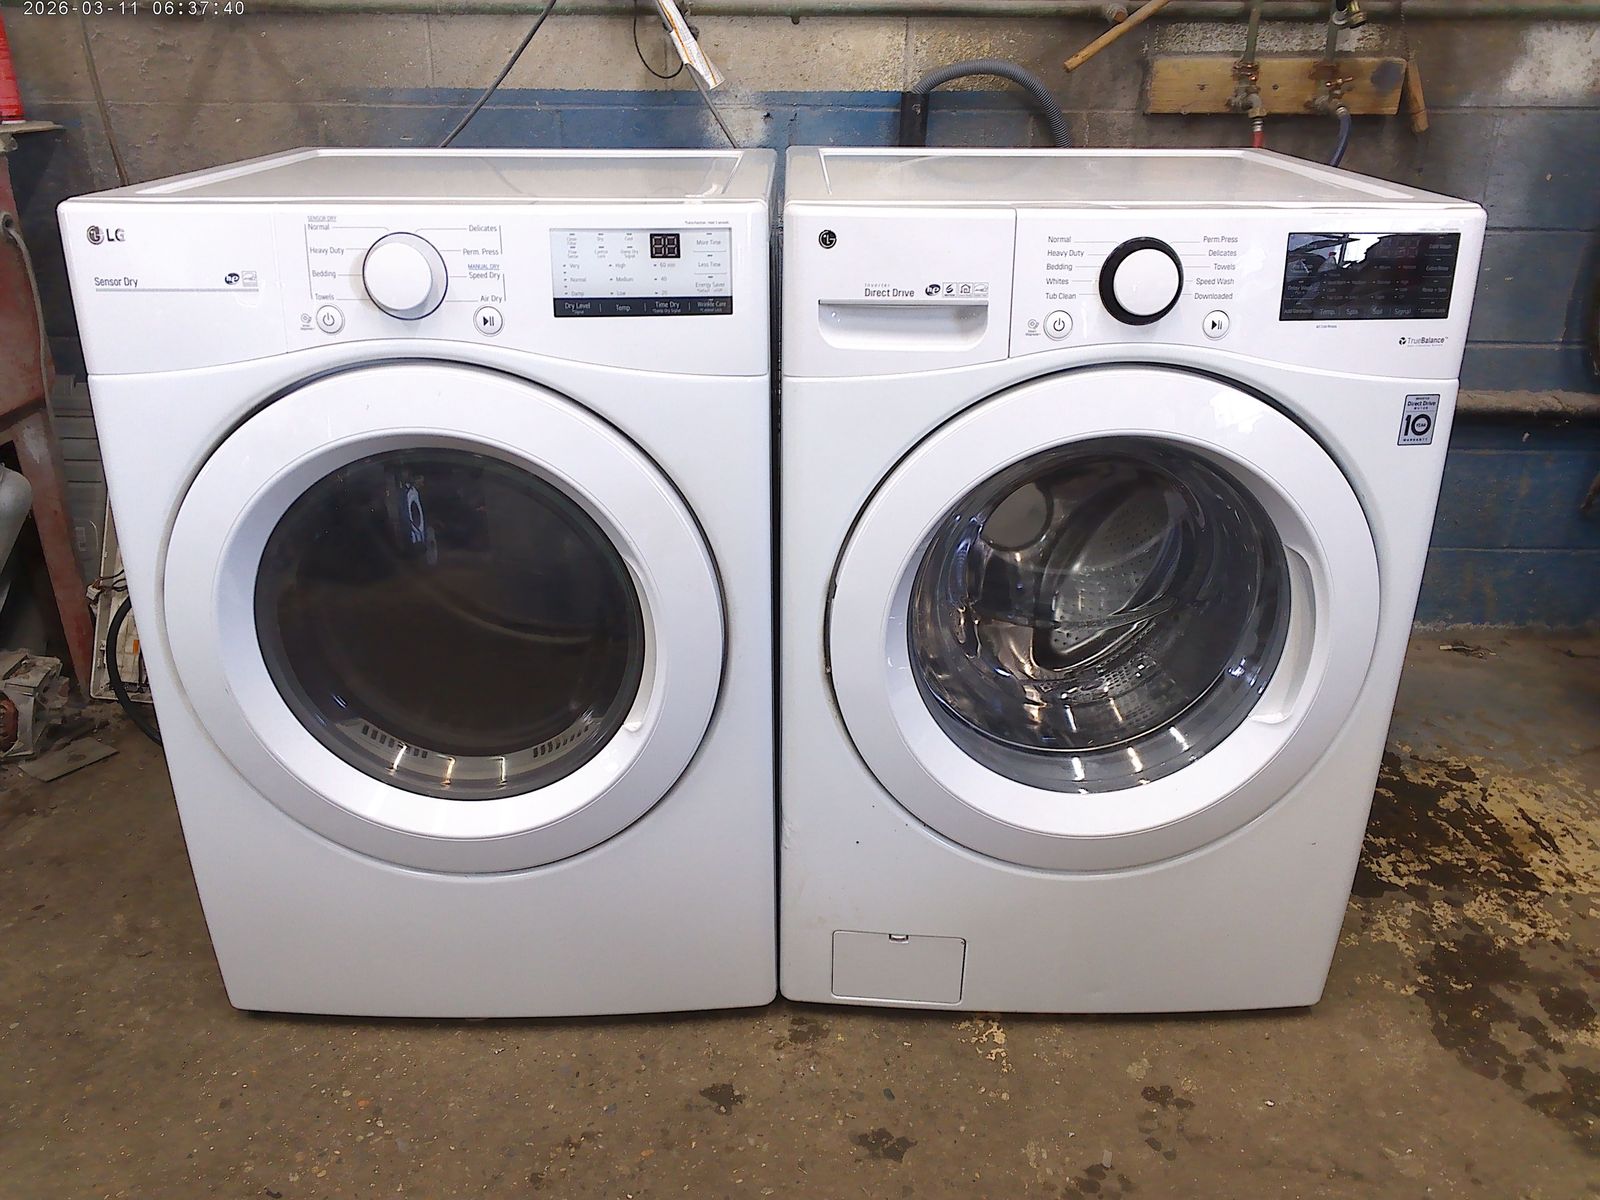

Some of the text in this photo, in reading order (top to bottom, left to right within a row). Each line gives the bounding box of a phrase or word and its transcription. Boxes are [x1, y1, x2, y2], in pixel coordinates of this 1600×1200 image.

[106, 228, 125, 242] LG
[310, 247, 344, 255] Heavy Duty
[1046, 263, 1073, 271] Bedding
[312, 270, 336, 278] Bedding
[489, 272, 500, 280] Dry
[94, 277, 139, 288] Sensor Dry
[864, 288, 915, 297] Direct Drive
[491, 295, 502, 303] Dry
[1404, 414, 1431, 436] 10
